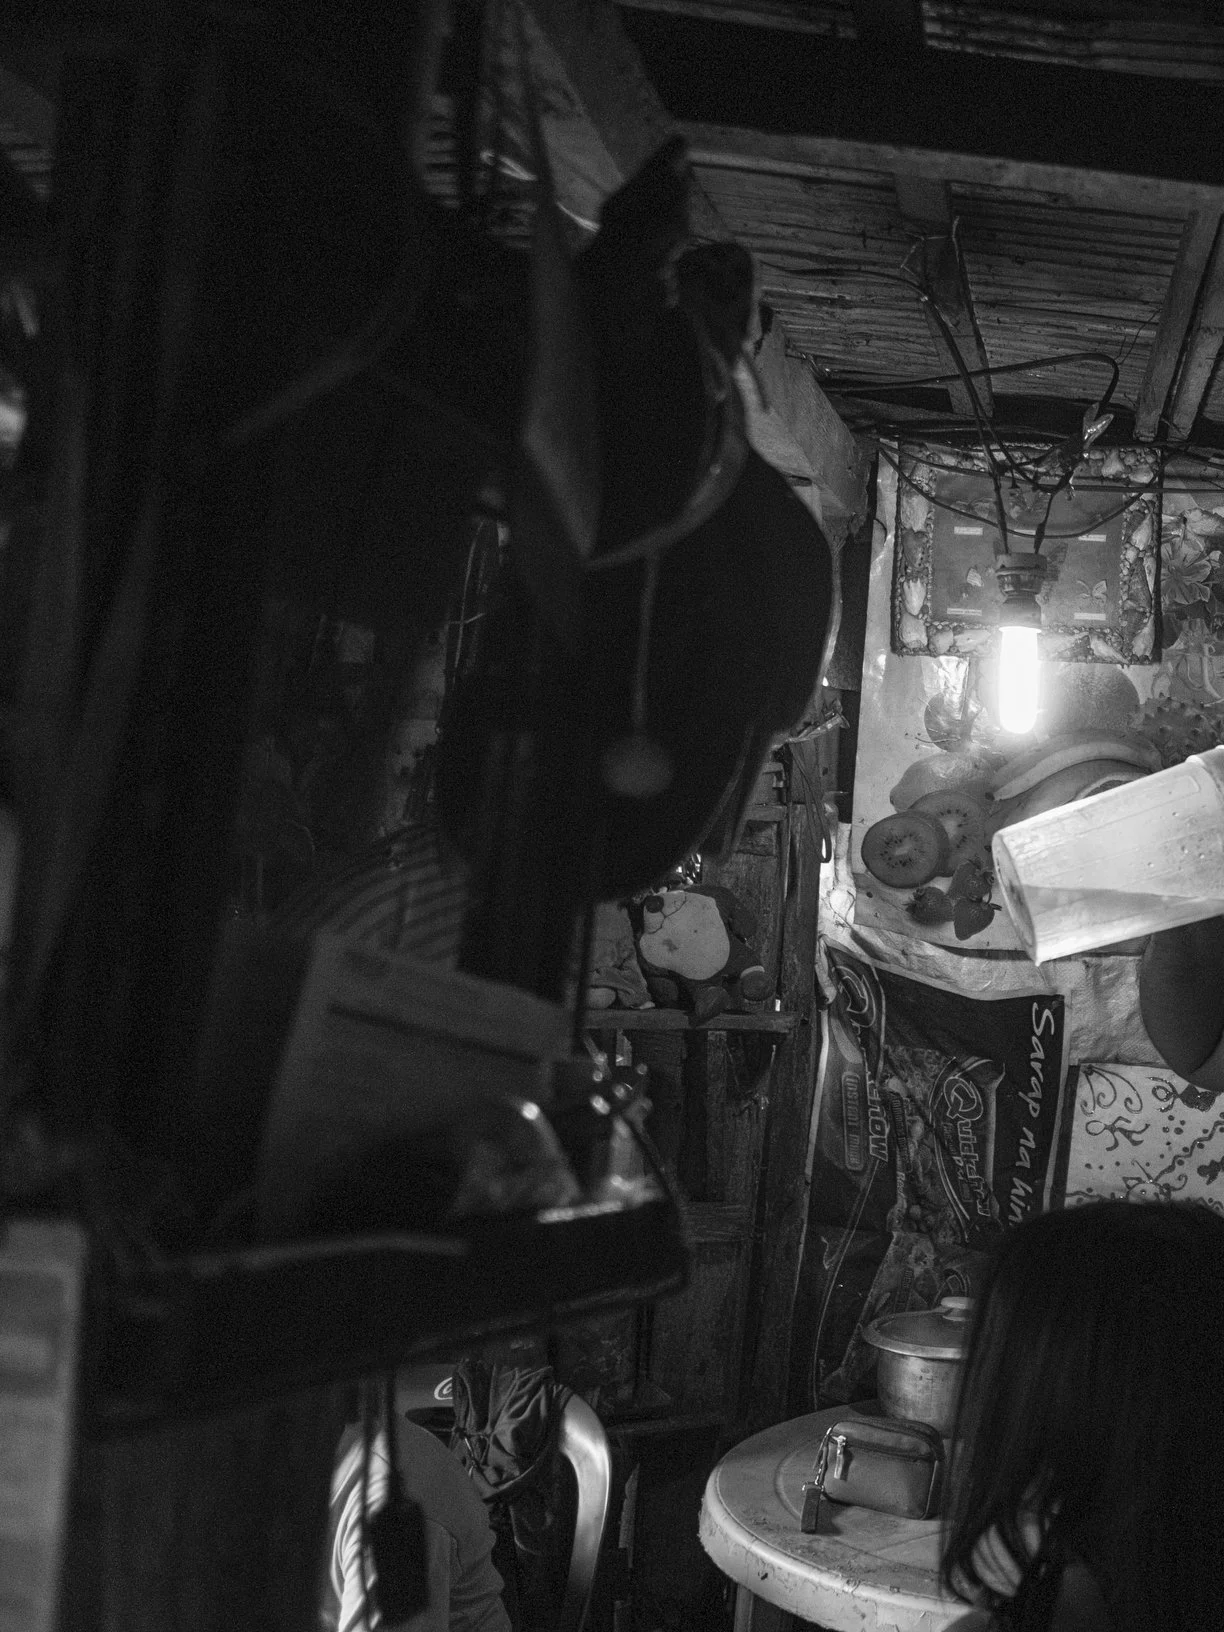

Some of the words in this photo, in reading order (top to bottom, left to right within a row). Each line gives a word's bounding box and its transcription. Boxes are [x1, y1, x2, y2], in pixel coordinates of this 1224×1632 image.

[1018, 1002, 1055, 1118] Sarap
[1015, 1126, 1036, 1169] na
[1008, 1177, 1033, 1227] hin
